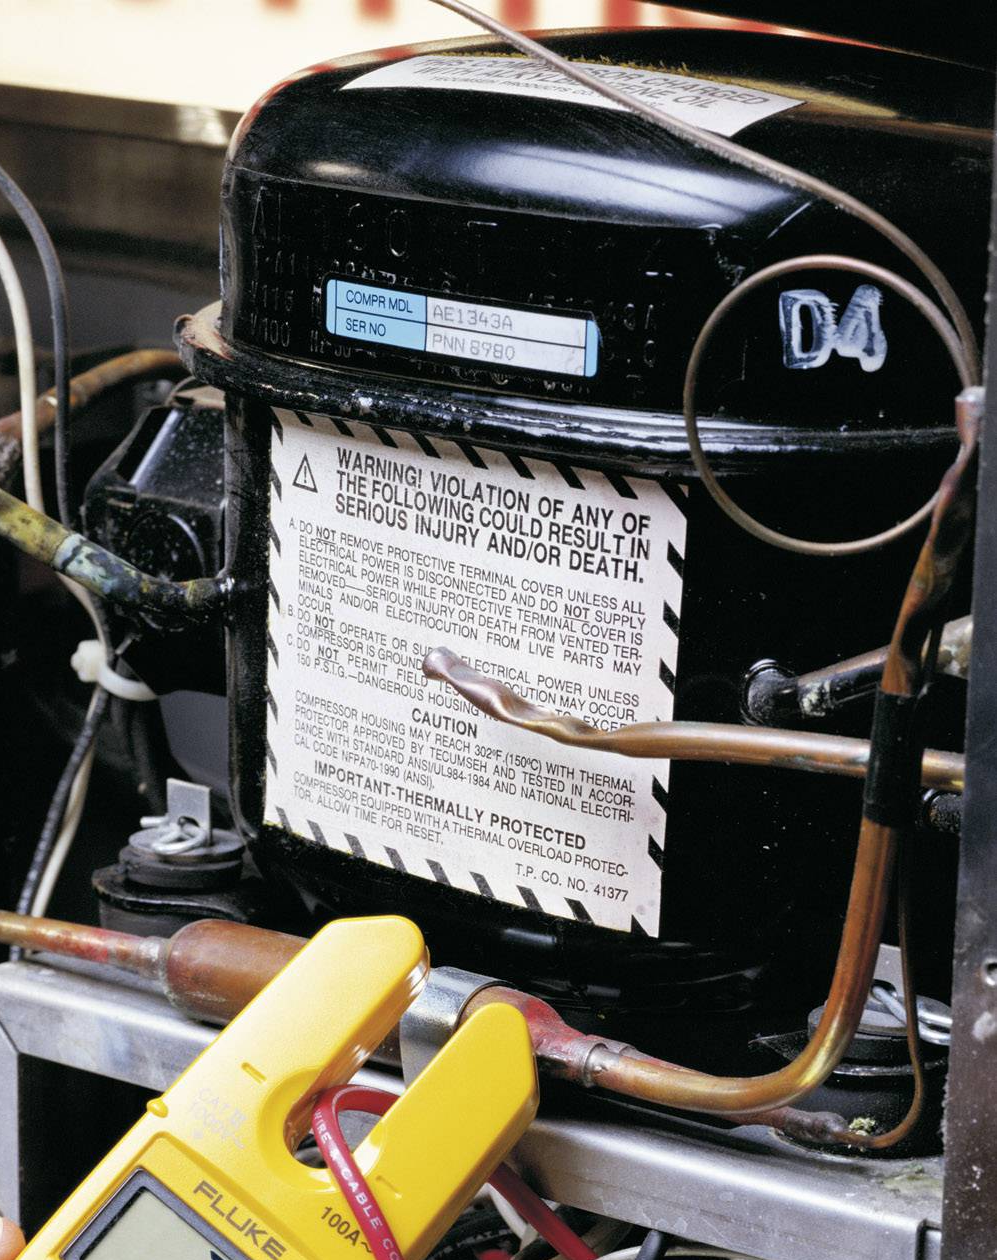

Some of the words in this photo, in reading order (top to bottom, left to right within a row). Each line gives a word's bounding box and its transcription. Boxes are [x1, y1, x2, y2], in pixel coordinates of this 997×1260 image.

[641, 77, 770, 104] CHARGED
[672, 95, 719, 109] OIL
[345, 290, 385, 309] COMPR
[388, 296, 414, 314] MDL
[432, 304, 514, 332] AE1343A
[345, 317, 367, 333] SER
[369, 321, 386, 337] NO
[432, 333, 465, 354] PNN
[469, 339, 516, 361] 8980
[780, 284, 889, 372] D4
[335, 469, 367, 497] THE
[371, 478, 474, 524] FOLLOWING
[478, 505, 542, 539] COULD
[548, 520, 625, 556] RESULT
[630, 536, 650, 561] IN
[337, 444, 423, 489] WARNING!
[429, 472, 530, 513] VIOLATION
[536, 496, 564, 521] OF
[571, 503, 614, 530] ANY
[619, 512, 651, 537] OF
[299, 520, 313, 535] DO
[316, 524, 336, 542] NOT
[340, 531, 383, 555] REMOVE
[387, 545, 455, 574] PROTECTIVE
[458, 563, 517, 588] TERMINAL
[520, 577, 563, 599] COVER
[567, 588, 618, 610] UNLESS
[621, 599, 646, 615] ALL
[335, 492, 408, 531] SERIOUS
[412, 512, 479, 549] INJURY
[486, 530, 561, 567] AND/OR
[568, 548, 644, 584] DEATH.
[298, 593, 333, 615] OCCUR.
[299, 534, 357, 563] ELECTRICAL
[361, 552, 399, 574] POWER
[404, 564, 413, 578] IS
[417, 568, 506, 601] DISCONNECTED
[510, 591, 535, 608] AND
[540, 597, 558, 613] DO
[563, 602, 590, 620] NOT
[594, 609, 645, 631] SUPPLY
[299, 549, 357, 577] ELECTRICAL
[361, 567, 399, 589] POWER
[402, 579, 436, 599] WHILE
[440, 589, 512, 618] PROTECTIVE
[516, 607, 579, 633] TERMINAL
[580, 622, 626, 643] COVER
[628, 631, 643, 646] IS
[296, 636, 310, 652] DO
[317, 643, 339, 661] NOT
[347, 653, 388, 676] PERMIT
[297, 607, 311, 623] DO
[314, 613, 334, 630] NOT
[339, 620, 386, 646] OPERATE
[391, 636, 407, 652] OR
[537, 673, 581, 695] POWER
[587, 685, 639, 707] UNLESS
[298, 578, 332, 600] MINALS
[339, 591, 378, 613] AND/OR
[385, 604, 478, 640] ELECTROCUTION
[486, 630, 519, 650] FROM
[528, 641, 554, 658] LIVE
[563, 648, 604, 669] PARTS
[612, 659, 641, 677] MAY
[415, 597, 455, 619] INJURY
[458, 608, 474, 624] OR
[478, 614, 517, 634] DEATH
[520, 624, 555, 643] FROM
[559, 632, 609, 655] VENTED
[612, 643, 643, 661] TER-
[296, 651, 310, 667] 150
[427, 691, 479, 716] HOUSING
[297, 622, 363, 654] COMPRESSOR
[366, 643, 375, 657] IS
[559, 694, 585, 711] MAY
[588, 700, 638, 722] OCCUR.
[294, 733, 310, 749] CAL
[312, 739, 338, 758] CODE
[295, 690, 357, 721] COMPRESSOR
[361, 711, 406, 735] HOUSING
[409, 725, 430, 742] MAY
[434, 732, 470, 753] REACH
[544, 761, 574, 779] WITH
[579, 769, 636, 793] THERMAL
[295, 704, 348, 732] PROTECTOR
[353, 723, 405, 750] APPROVED
[410, 740, 424, 755] BY
[429, 746, 487, 773] TECUMSEH
[492, 763, 516, 780] AND
[520, 770, 565, 793] TESTED
[568, 782, 582, 797] IN
[587, 786, 636, 809] ACCOR-
[411, 706, 477, 739] CAUTION
[295, 719, 323, 739] DANCE
[326, 729, 349, 747] WITH
[353, 738, 404, 764] STANDARD
[493, 778, 517, 796] AND
[520, 785, 577, 810] NATIONAL
[580, 800, 636, 824] ELECTRI-
[293, 785, 312, 802] TOR.
[316, 793, 348, 815] ALLOW
[354, 806, 377, 824] TIME
[381, 814, 402, 832] FOR
[406, 822, 444, 844] RESET.
[294, 771, 358, 803] COMPRESSOR
[360, 793, 411, 820] EQUIPPED
[413, 809, 440, 828] WITH
[442, 818, 450, 831] A
[451, 821, 505, 847] THERMAL
[507, 836, 572, 864] OVERLOAD
[574, 853, 629, 878] PROTEC-
[490, 812, 586, 850] PROTECTED
[514, 862, 537, 880] T.P.
[540, 868, 562, 886] CO.
[567, 875, 589, 893] NO.
[593, 882, 629, 902] 41377
[340, 1168, 384, 1230] CABLE
